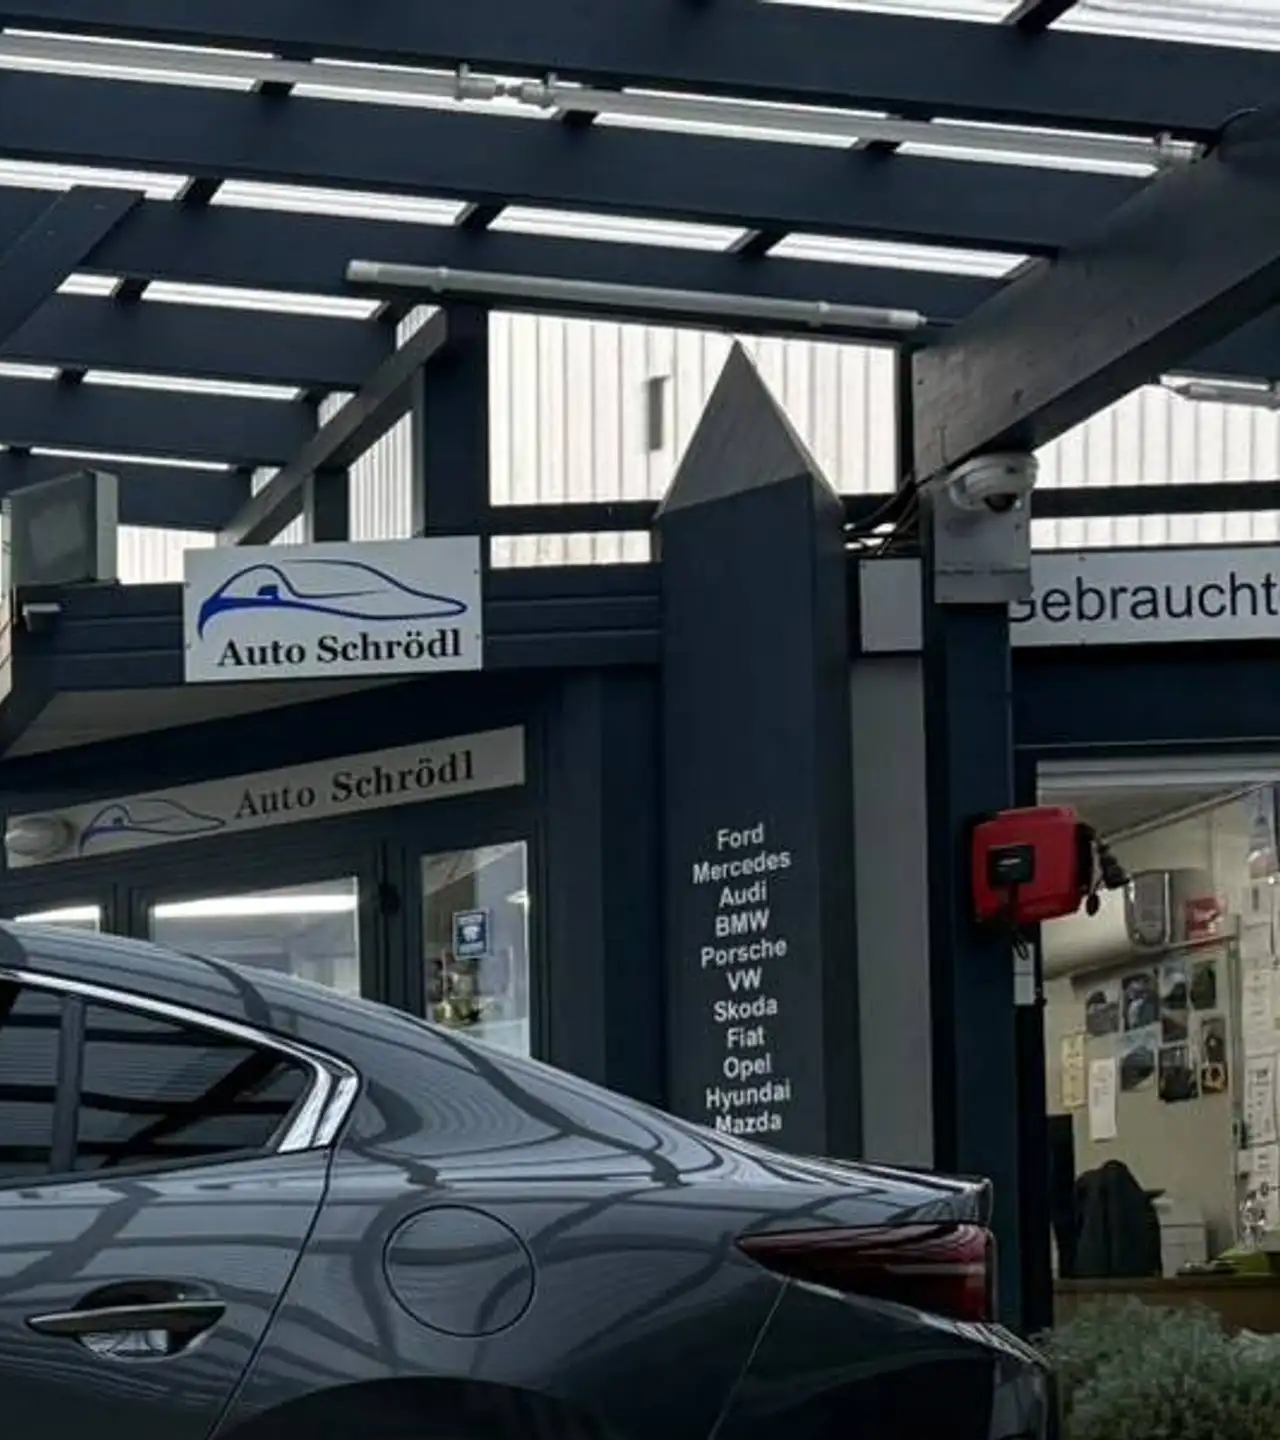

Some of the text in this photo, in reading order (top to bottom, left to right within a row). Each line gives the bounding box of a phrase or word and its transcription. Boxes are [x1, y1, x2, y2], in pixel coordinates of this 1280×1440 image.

[218, 629, 462, 667] Auto Schrödl
[235, 750, 474, 819] Auto Schrödl
[717, 822, 764, 850] Ford
[692, 851, 791, 884] Mercedes
[719, 881, 768, 907] Audi
[715, 909, 769, 937] BMW
[701, 938, 787, 968] Porsche
[727, 967, 762, 991] VW
[713, 996, 778, 1022] Skoda
[727, 1025, 765, 1048] Fiat
[723, 1053, 771, 1082] Opel
[706, 1078, 792, 1112] Hyundai
[715, 1111, 782, 1135] Mazda
